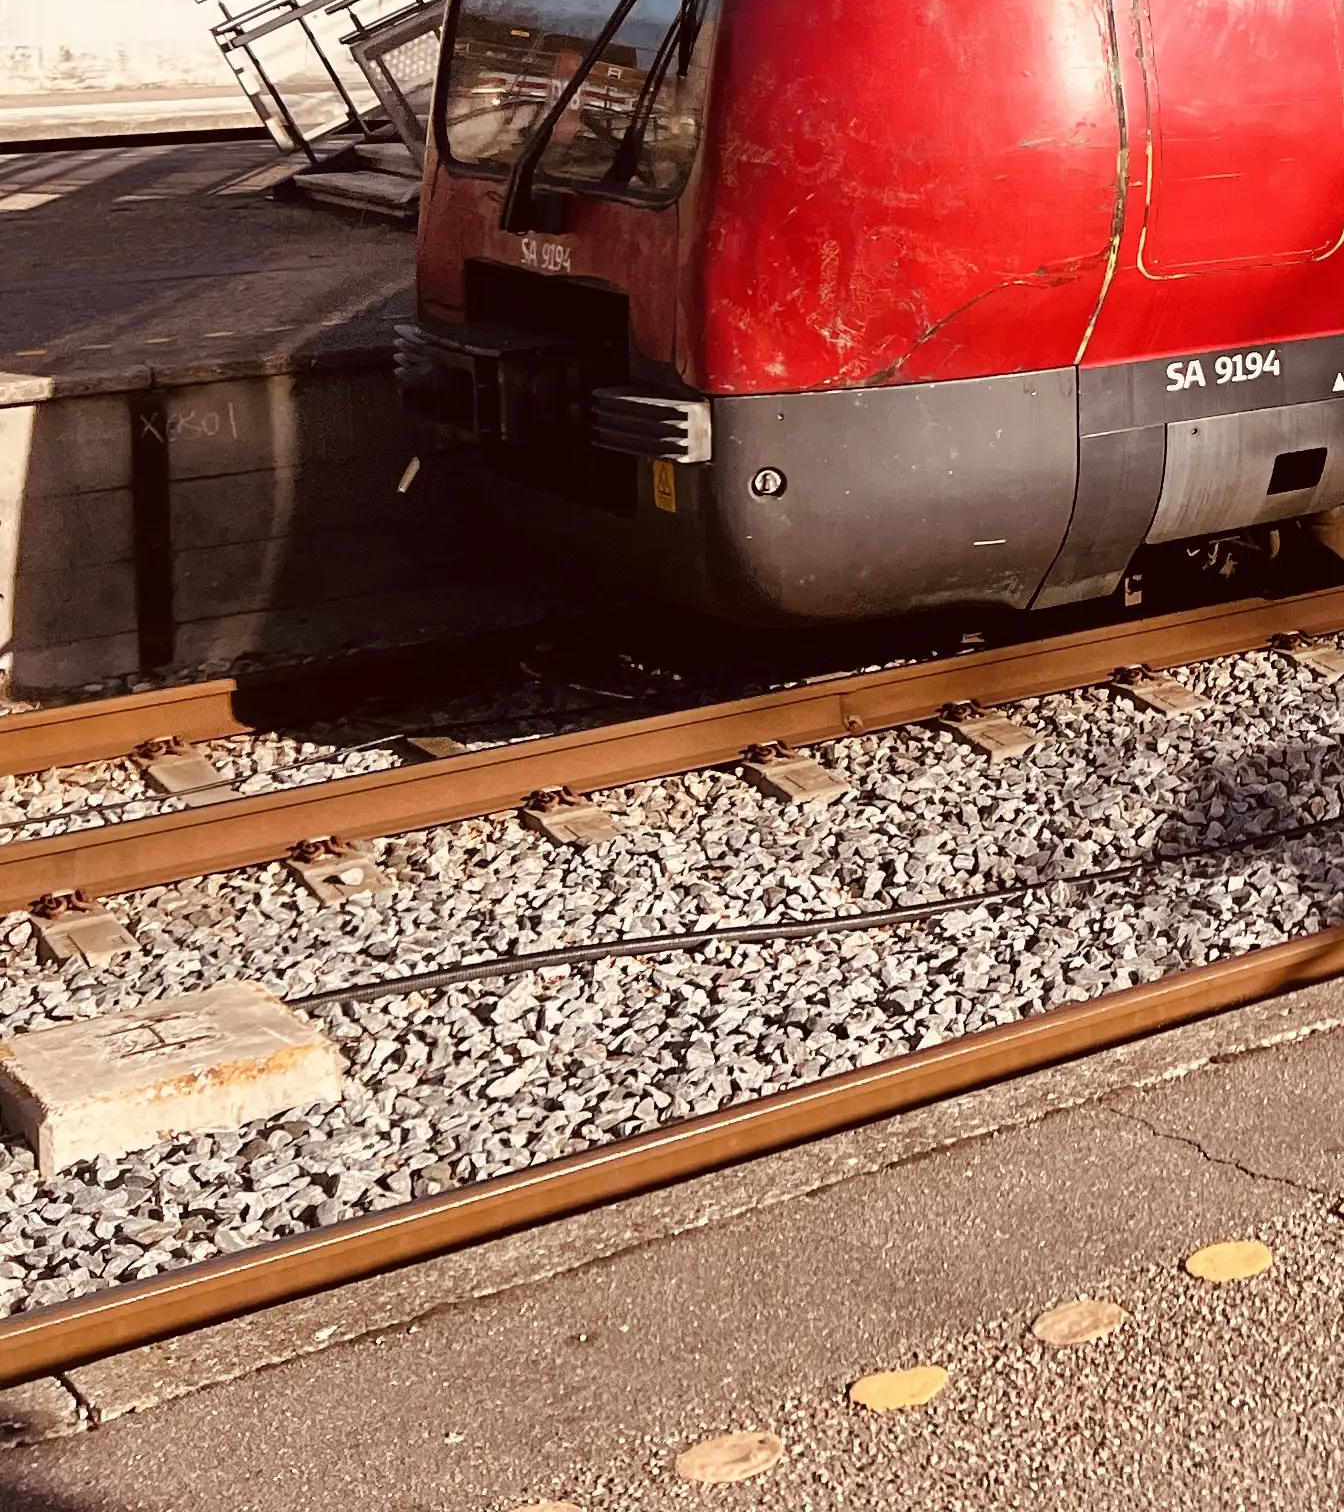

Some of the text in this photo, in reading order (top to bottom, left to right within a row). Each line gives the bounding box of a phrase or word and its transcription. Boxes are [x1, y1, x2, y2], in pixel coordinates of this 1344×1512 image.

[520, 237, 571, 273] SA 9194
[1166, 349, 1280, 392] SA 9194
